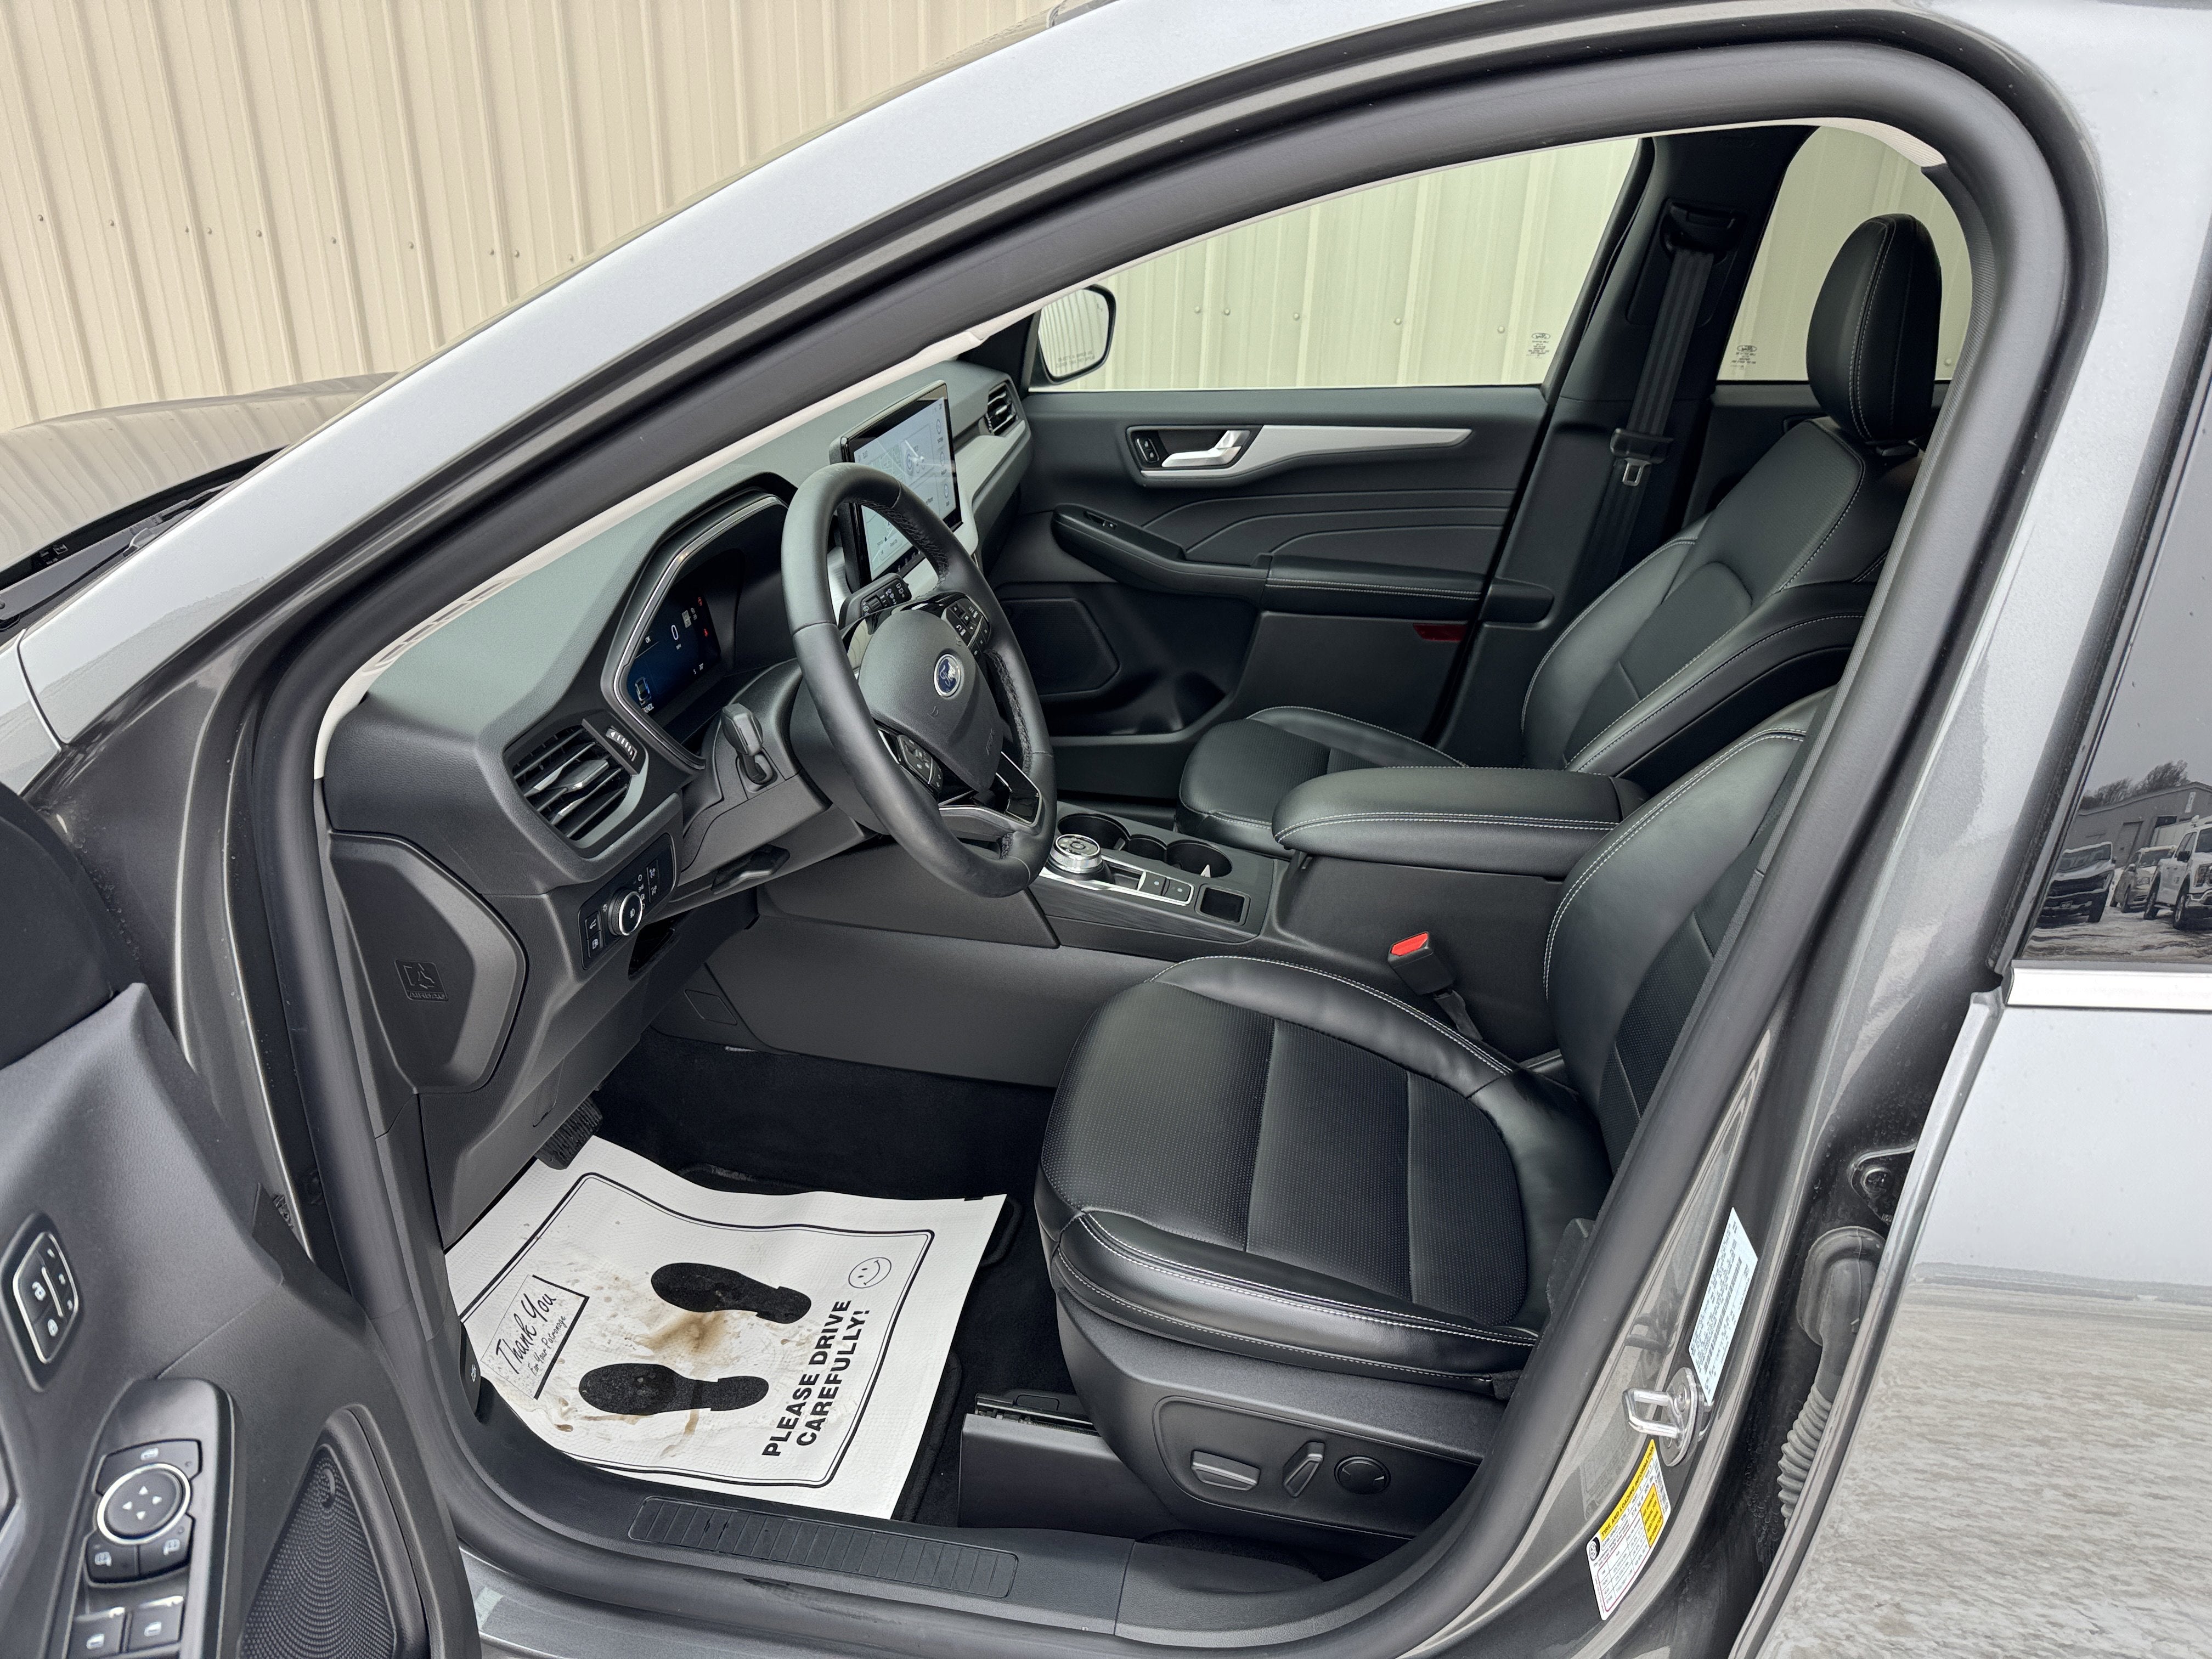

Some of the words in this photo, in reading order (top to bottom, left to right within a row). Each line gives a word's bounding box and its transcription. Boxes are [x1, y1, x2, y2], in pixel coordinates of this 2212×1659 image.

[939, 662, 956, 687] Ford
[409, 991, 445, 1000] AIRBAG
[495, 1313, 537, 1375] Thank
[521, 1293, 557, 1322] You
[528, 1363, 539, 1376] For
[534, 1348, 548, 1364] Your
[541, 1316, 568, 1350] Patronage
[761, 1374, 820, 1457] PLEASE
[808, 1300, 851, 1365] DRIVE
[796, 1310, 870, 1446] CAREFULLY!
[1601, 1523, 1611, 1537] TIRE
[1611, 1510, 1620, 1525] AND
[1619, 1486, 1635, 1513] LOADING
[1634, 1443, 1654, 1487] INFORMATION
